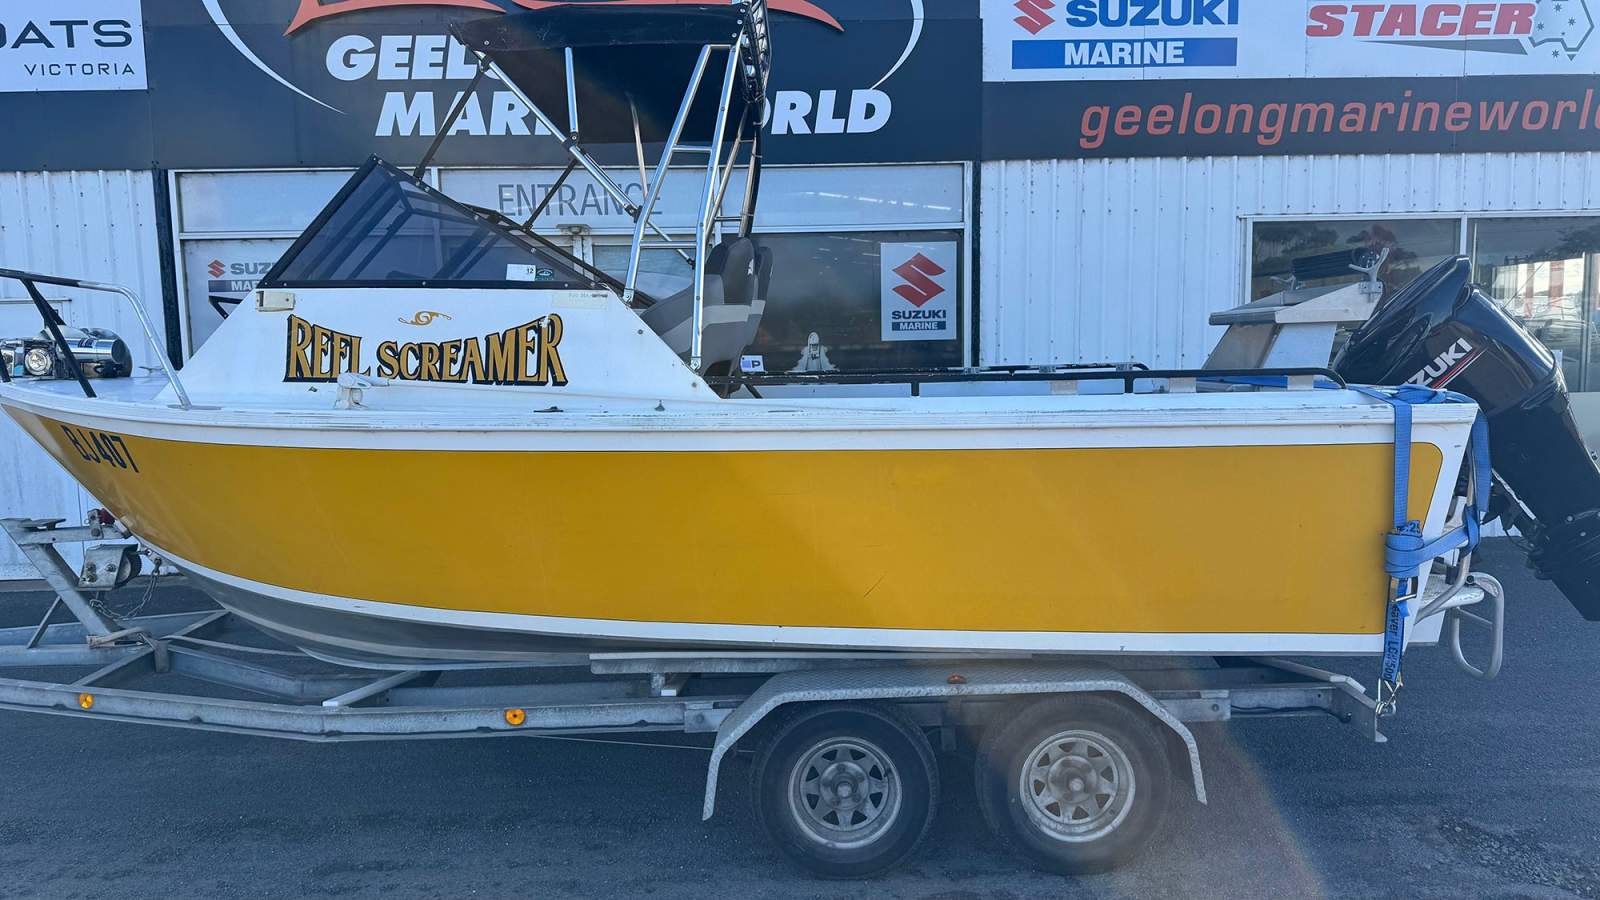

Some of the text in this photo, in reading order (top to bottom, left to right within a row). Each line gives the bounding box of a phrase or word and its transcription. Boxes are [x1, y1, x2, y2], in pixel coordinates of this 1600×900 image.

[1066, 0, 1239, 27] SUZUKI
[1305, 3, 1536, 37] STACER
[0, 20, 132, 48] ATS
[24, 63, 134, 76] VICTORIA
[325, 34, 500, 81] GEEL
[1064, 41, 1185, 65] MARINE
[762, 89, 892, 135] RLD
[1079, 88, 1600, 149] geelongmarineworl
[498, 183, 662, 216] ENTRANCE
[230, 262, 275, 275] SUZ
[892, 309, 947, 319] SUZUKI
[899, 321, 938, 331] MARINE
[376, 313, 569, 386] SCREAMER
[1401, 337, 1473, 387] ZUKI
[61, 425, 140, 473] BJ407
